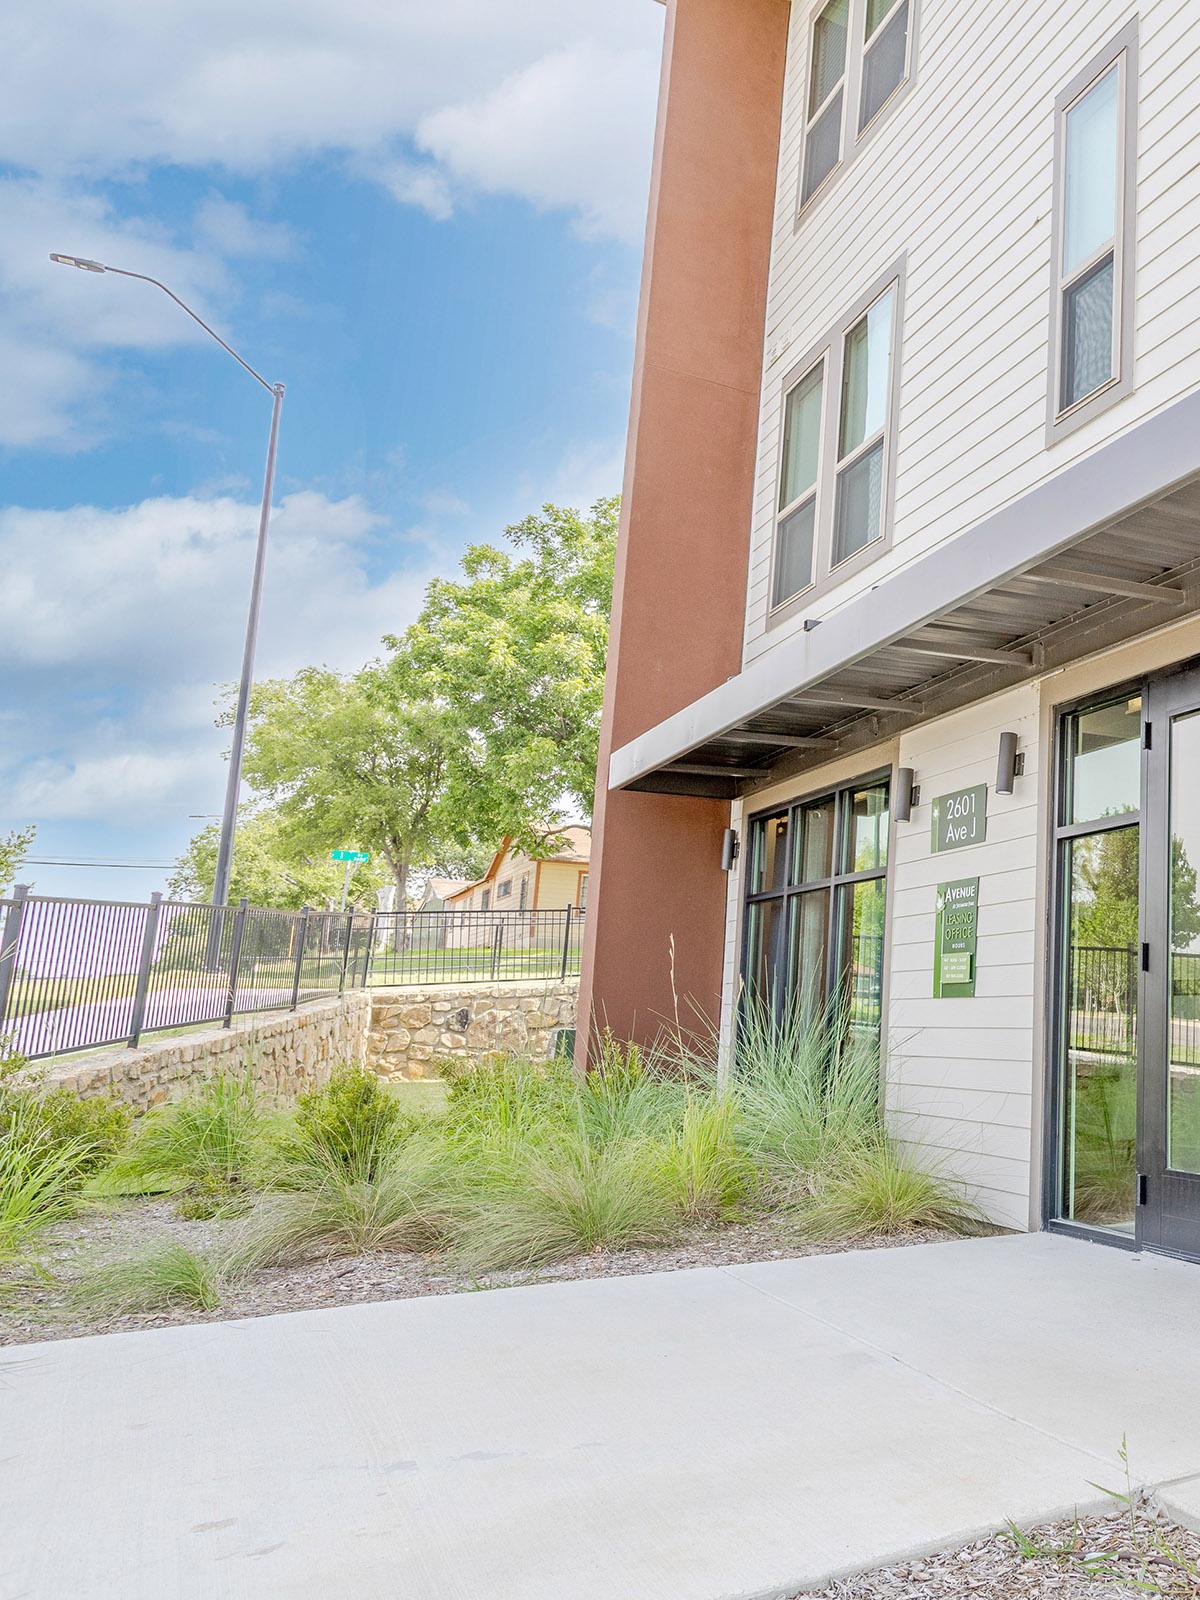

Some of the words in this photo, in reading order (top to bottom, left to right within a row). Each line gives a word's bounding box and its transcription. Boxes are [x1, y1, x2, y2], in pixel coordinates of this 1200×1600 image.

[946, 793, 975, 819] 2601
[945, 823, 967, 843] Ave
[971, 817, 976, 838] J
[945, 885, 975, 903] AVENUE
[945, 911, 974, 926] LEASING
[945, 926, 973, 941] OFFICE
